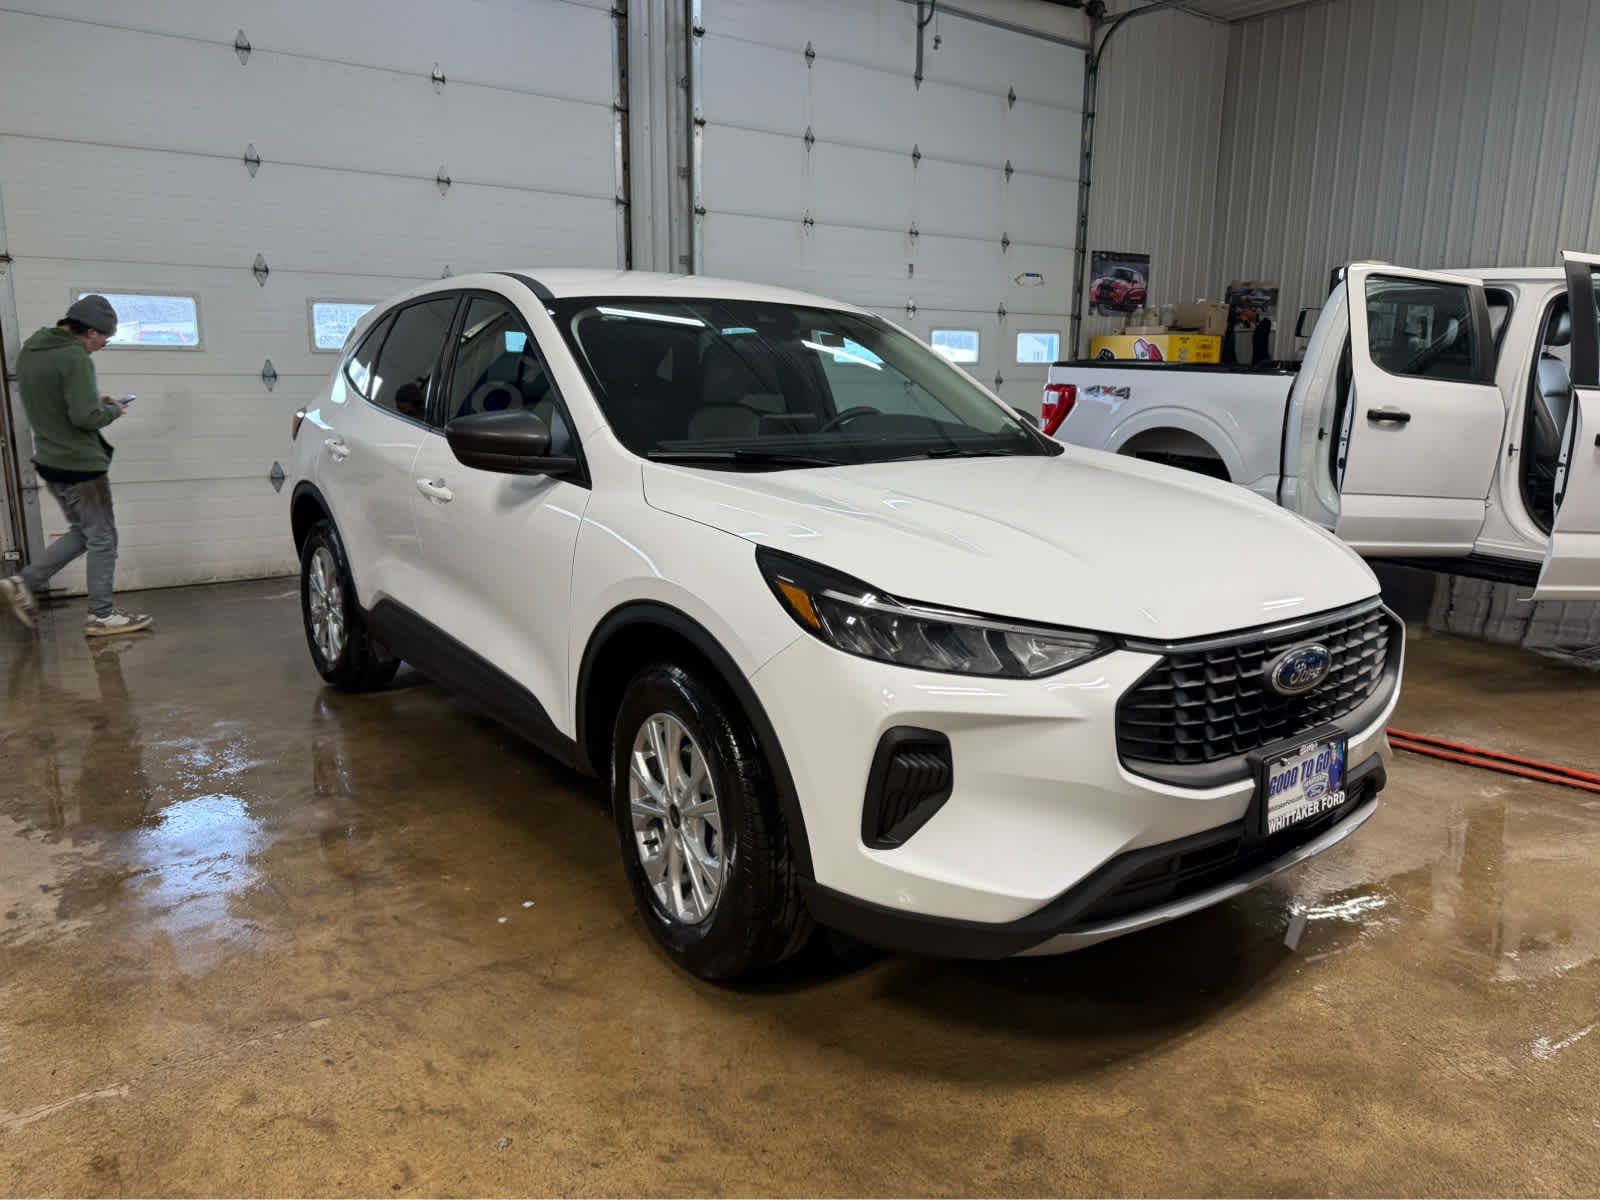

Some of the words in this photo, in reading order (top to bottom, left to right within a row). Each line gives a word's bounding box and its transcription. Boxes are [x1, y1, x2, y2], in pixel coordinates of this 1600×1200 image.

[1289, 660, 1323, 686] Ford
[1269, 766, 1299, 798] GOOD
[1301, 758, 1315, 781] TO
[1316, 751, 1330, 774] GO
[1268, 801, 1319, 834] WHITTAKER
[1322, 791, 1346, 811] FORD
